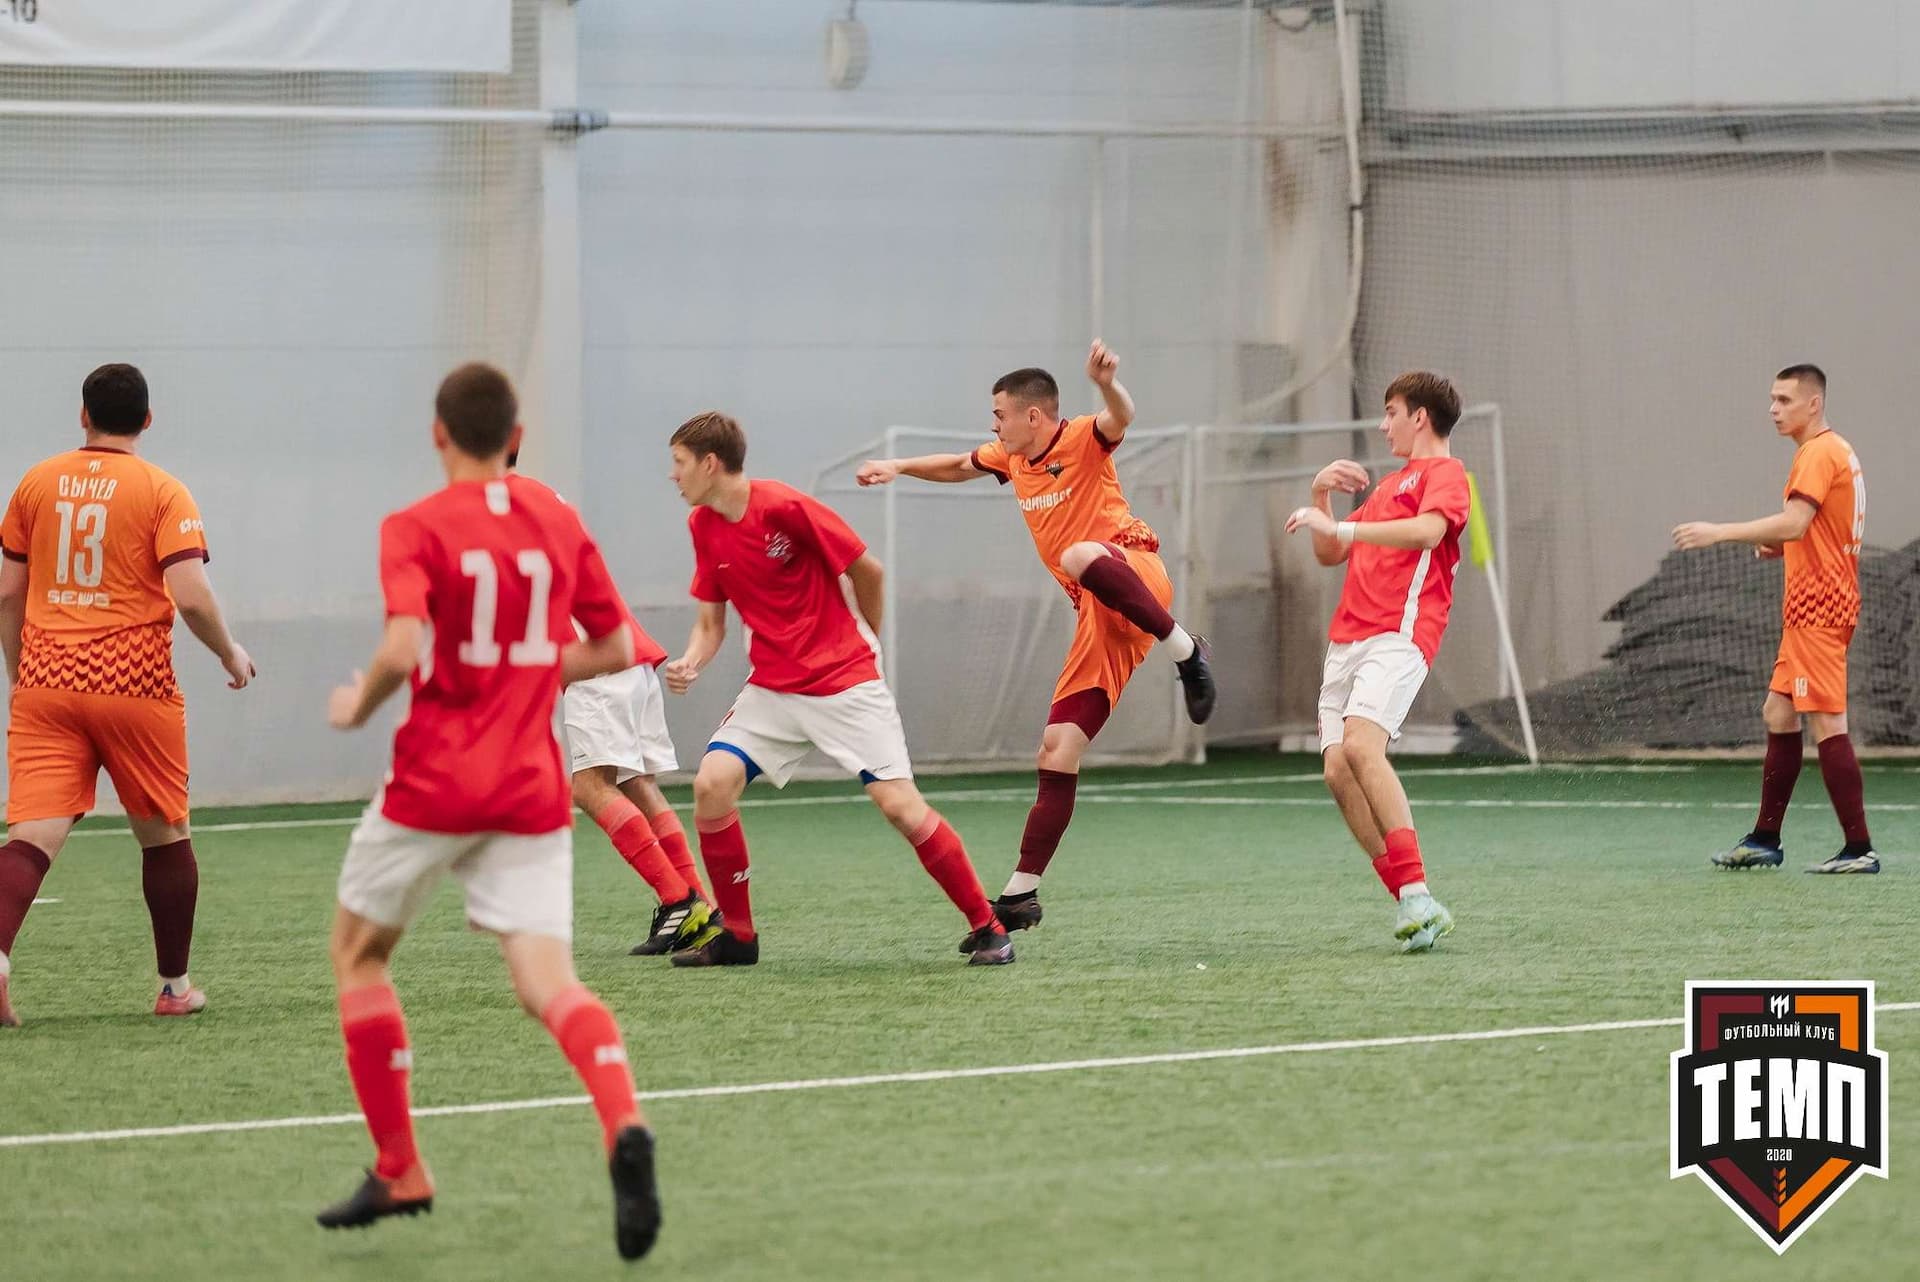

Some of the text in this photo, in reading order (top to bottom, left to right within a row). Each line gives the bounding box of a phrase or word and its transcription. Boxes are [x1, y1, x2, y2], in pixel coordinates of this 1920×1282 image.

[58, 475, 118, 500] СЫЧЕВ
[55, 501, 107, 587] 13
[458, 549, 559, 667] 11
